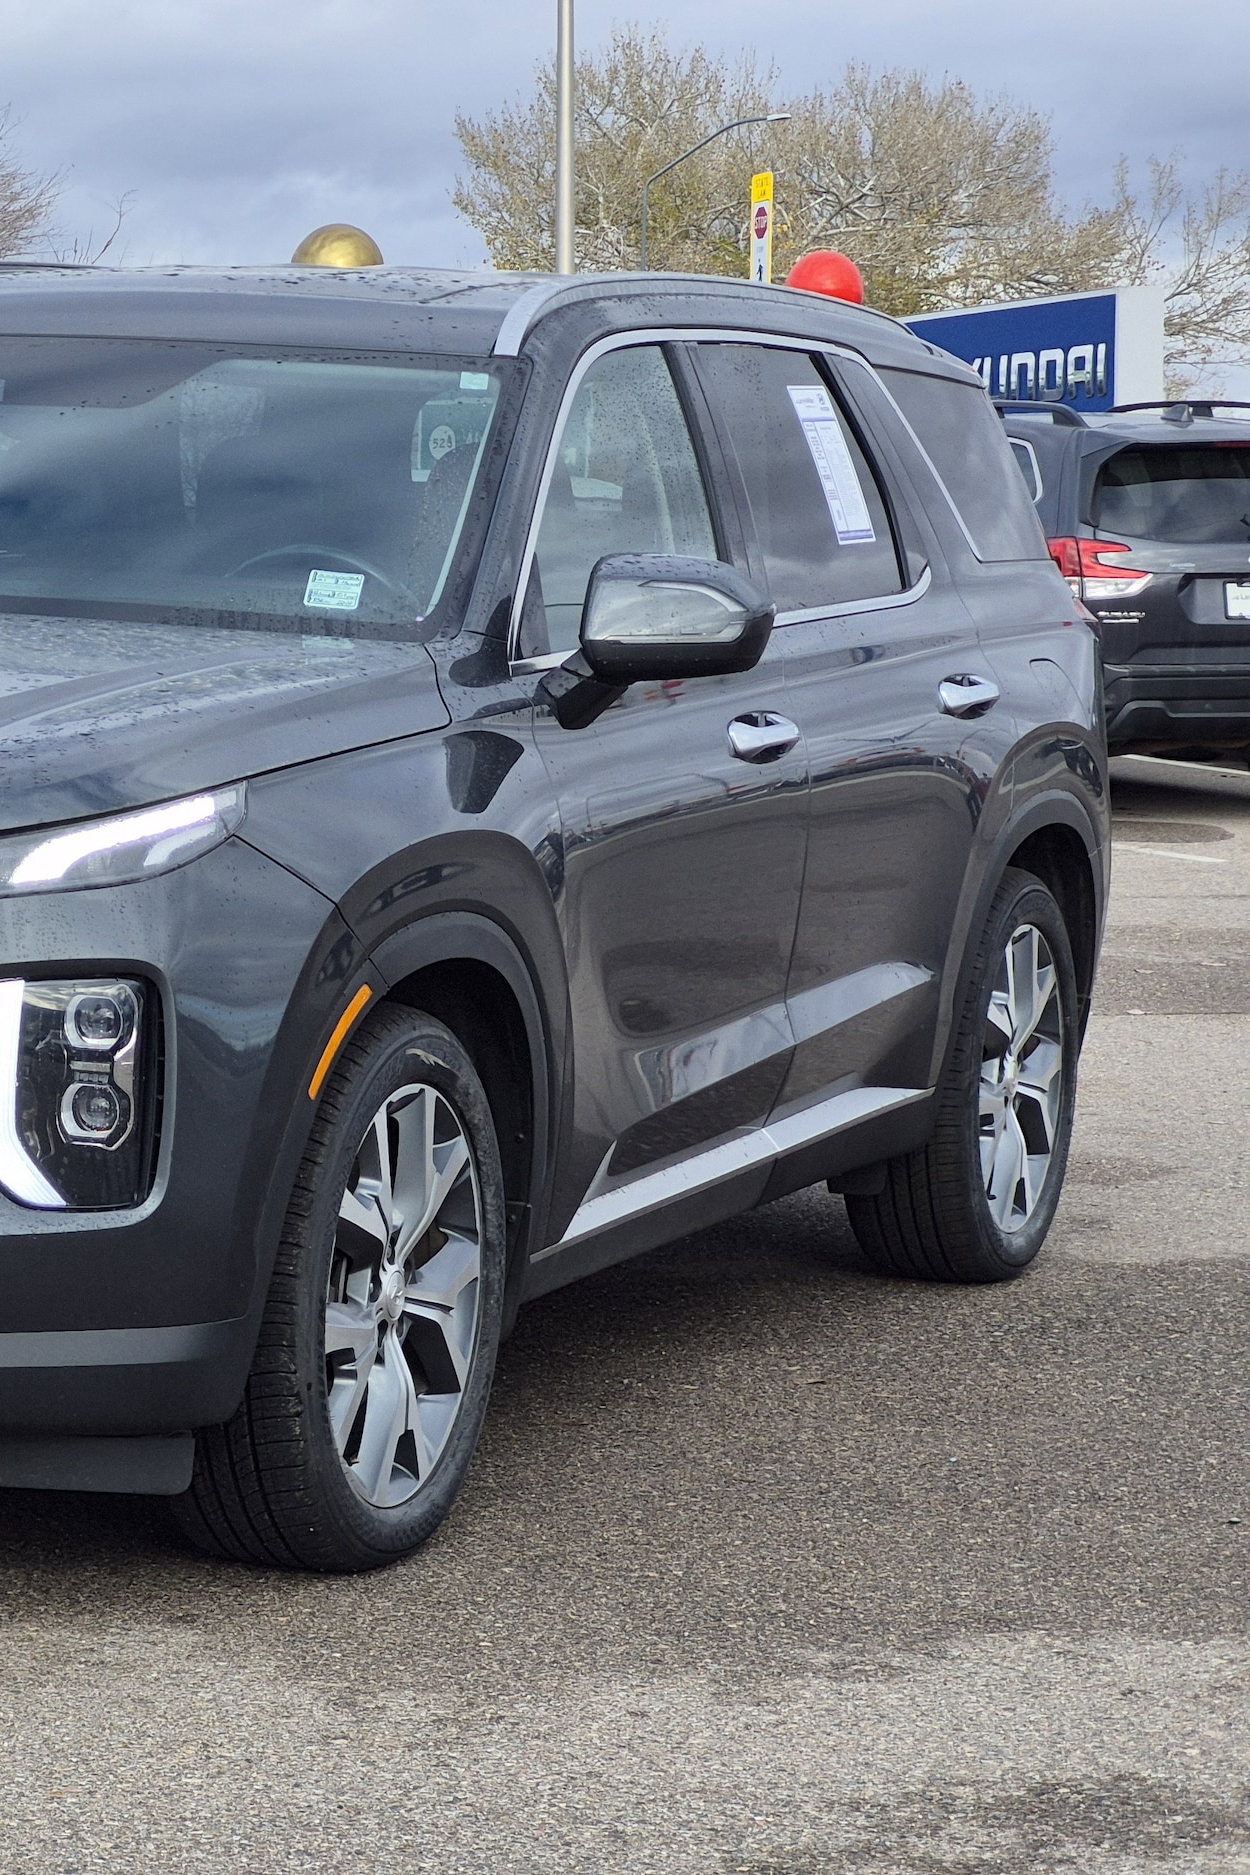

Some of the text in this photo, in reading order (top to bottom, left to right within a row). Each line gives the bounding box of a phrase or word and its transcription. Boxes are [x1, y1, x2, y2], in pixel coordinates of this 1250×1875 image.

[755, 177, 769, 188] STATE
[755, 216, 767, 229] STOP
[972, 342, 1107, 401] UNDAI
